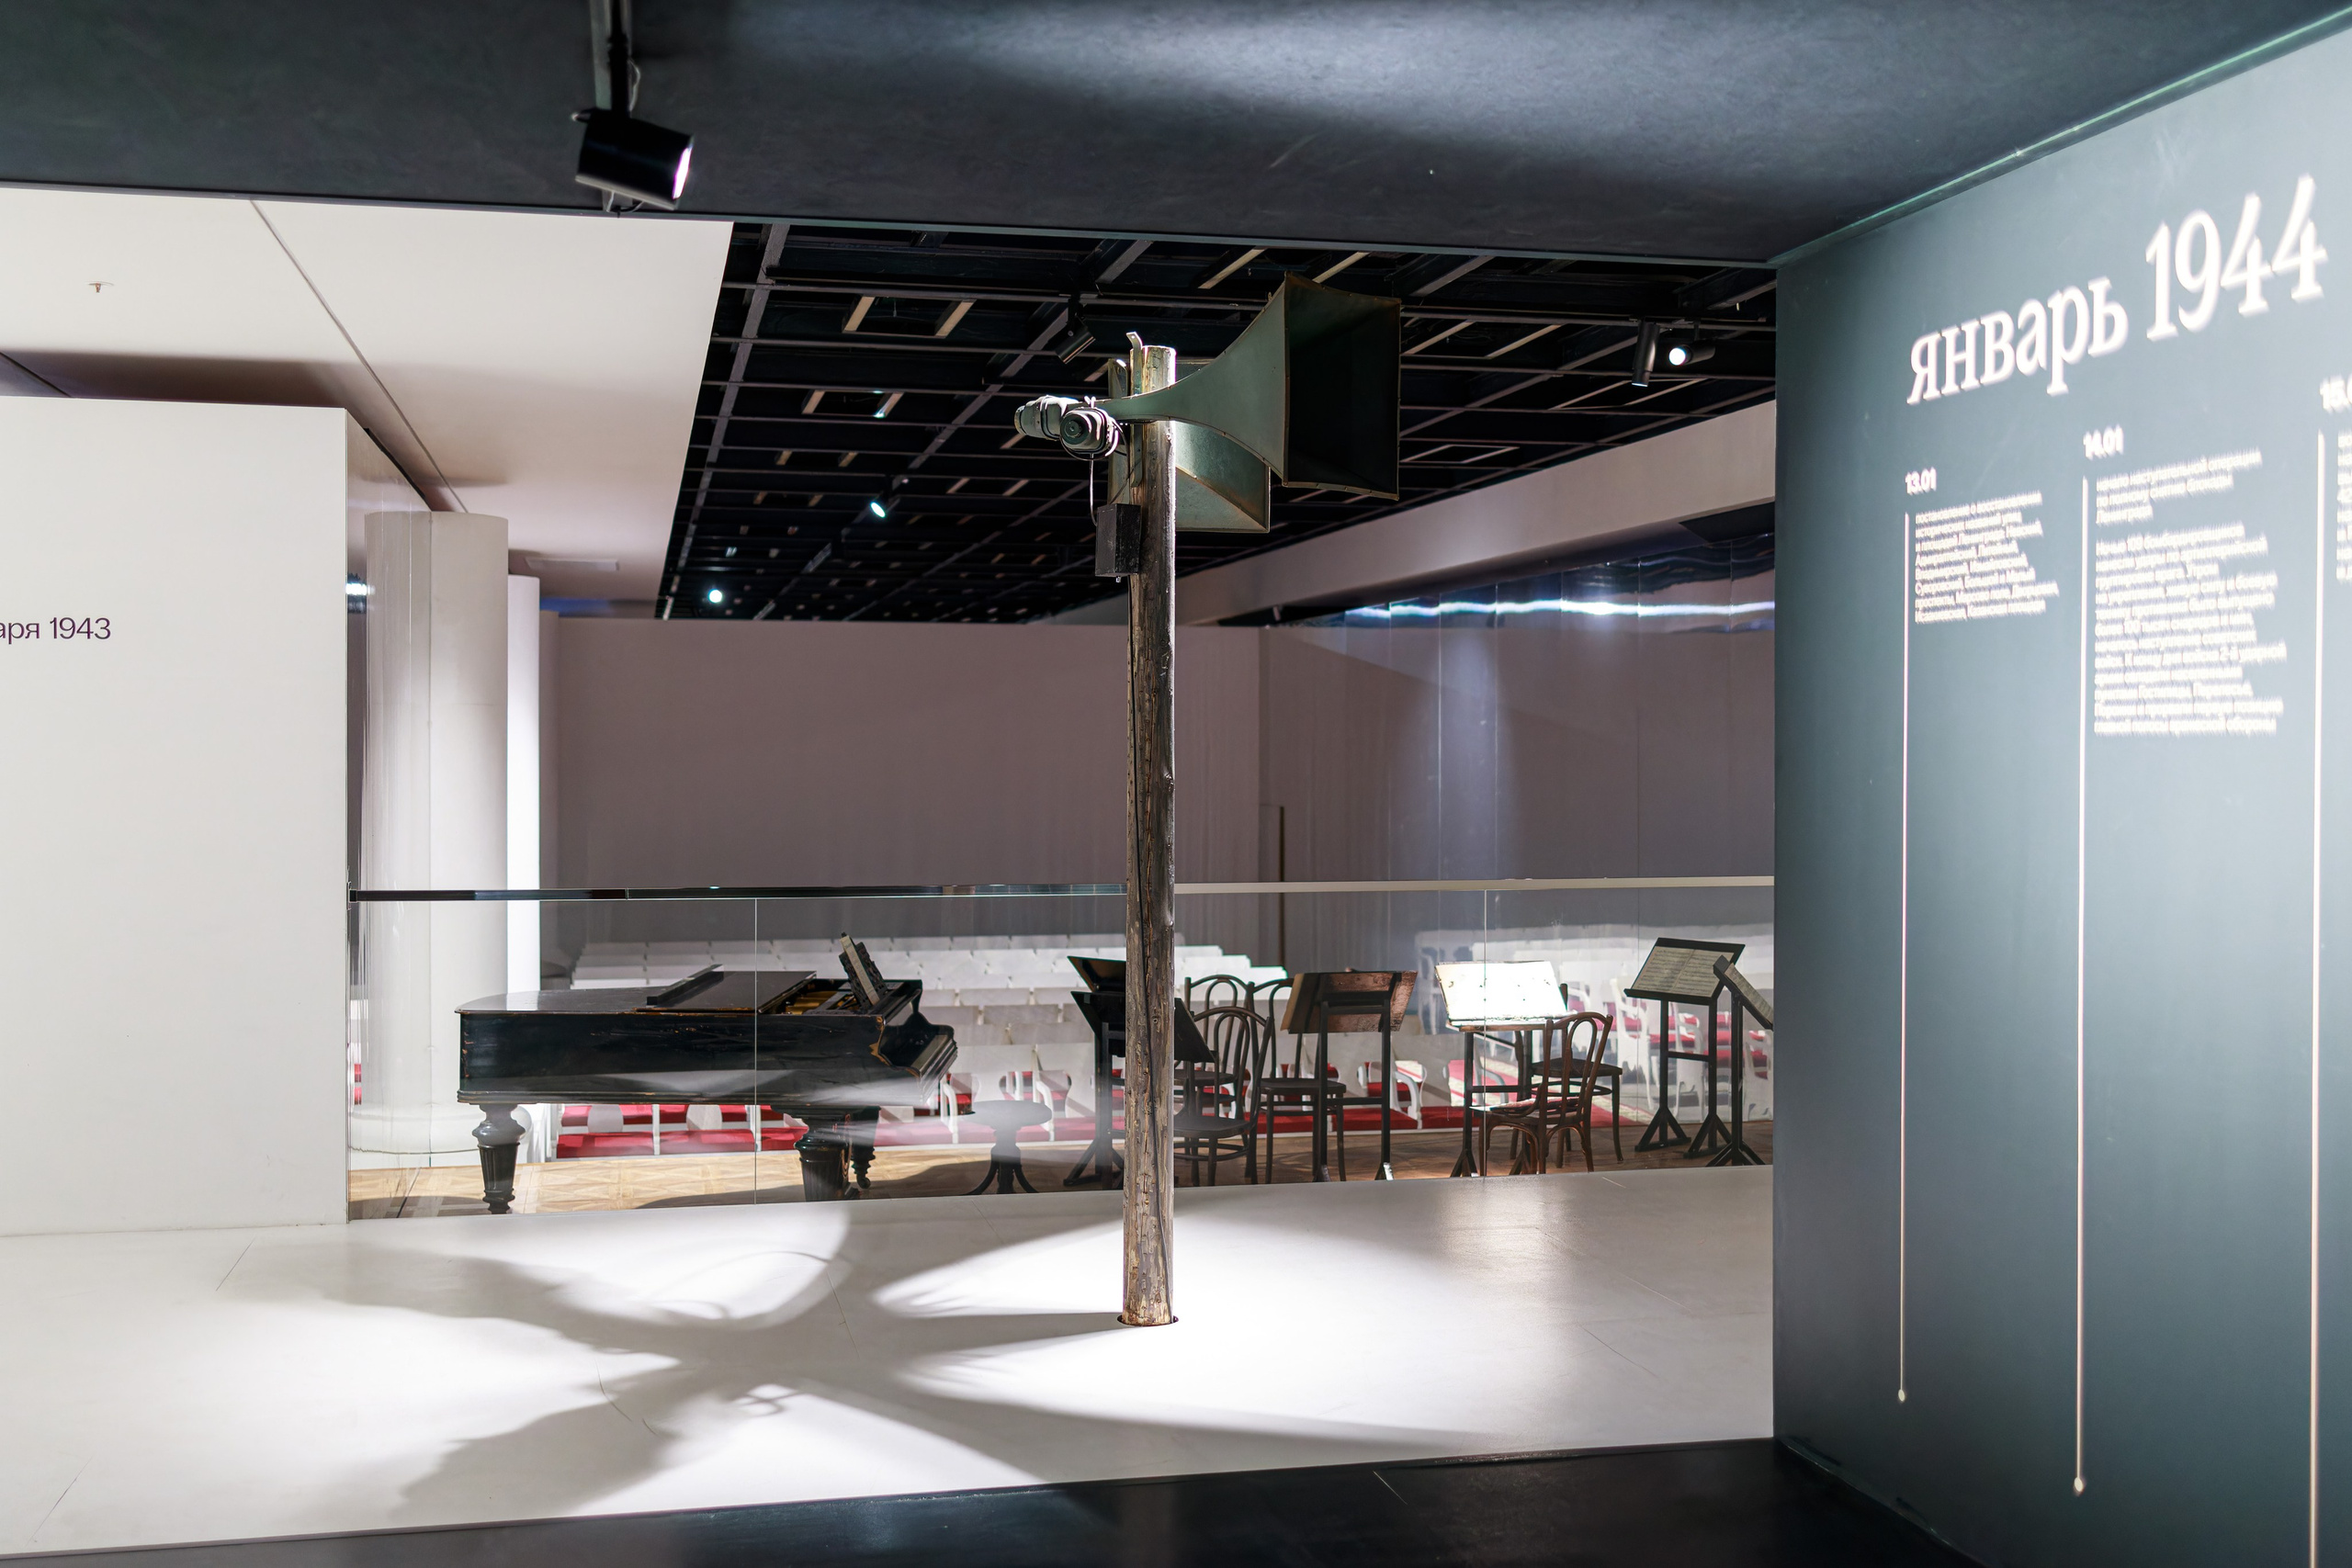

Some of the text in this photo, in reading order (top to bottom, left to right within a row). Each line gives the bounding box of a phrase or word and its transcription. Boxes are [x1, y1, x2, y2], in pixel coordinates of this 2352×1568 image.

[1906, 173, 2328, 405] январь 1944
[2083, 424, 2124, 460] 14.01
[1905, 468, 1937, 496] 13.01
[50, 616, 111, 639] 1943
